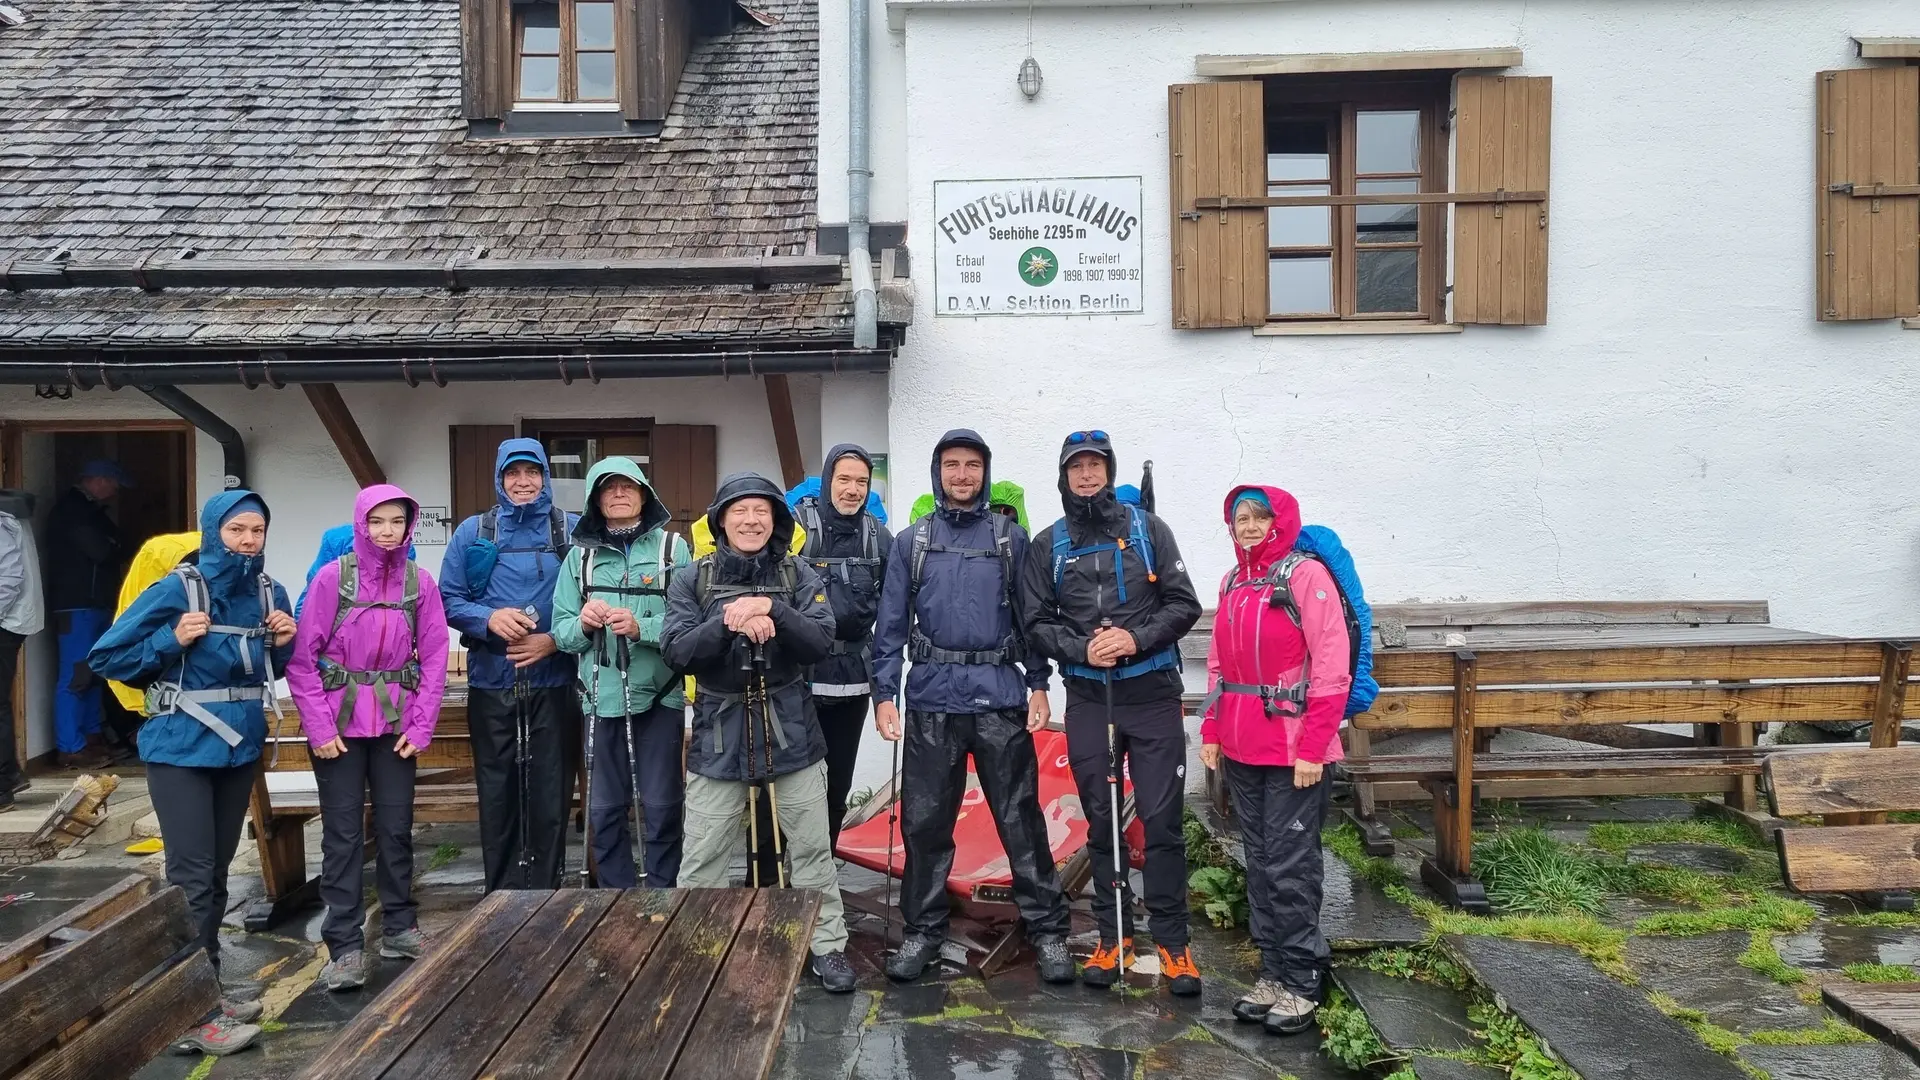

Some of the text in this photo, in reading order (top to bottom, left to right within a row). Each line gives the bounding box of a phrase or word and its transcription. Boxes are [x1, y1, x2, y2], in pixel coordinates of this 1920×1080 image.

[937, 185, 1138, 244] FURTSCHAGLHAUS
[989, 224, 1087, 241] Seehöhe 2295 m
[956, 254, 985, 267] Erbaut
[1078, 252, 1121, 265] Erweitert
[960, 271, 981, 284] 1888
[948, 293, 1130, 311] D.A.V. Sektion Berlin
[419, 511, 440, 519] haus
[422, 520, 434, 528] NN
